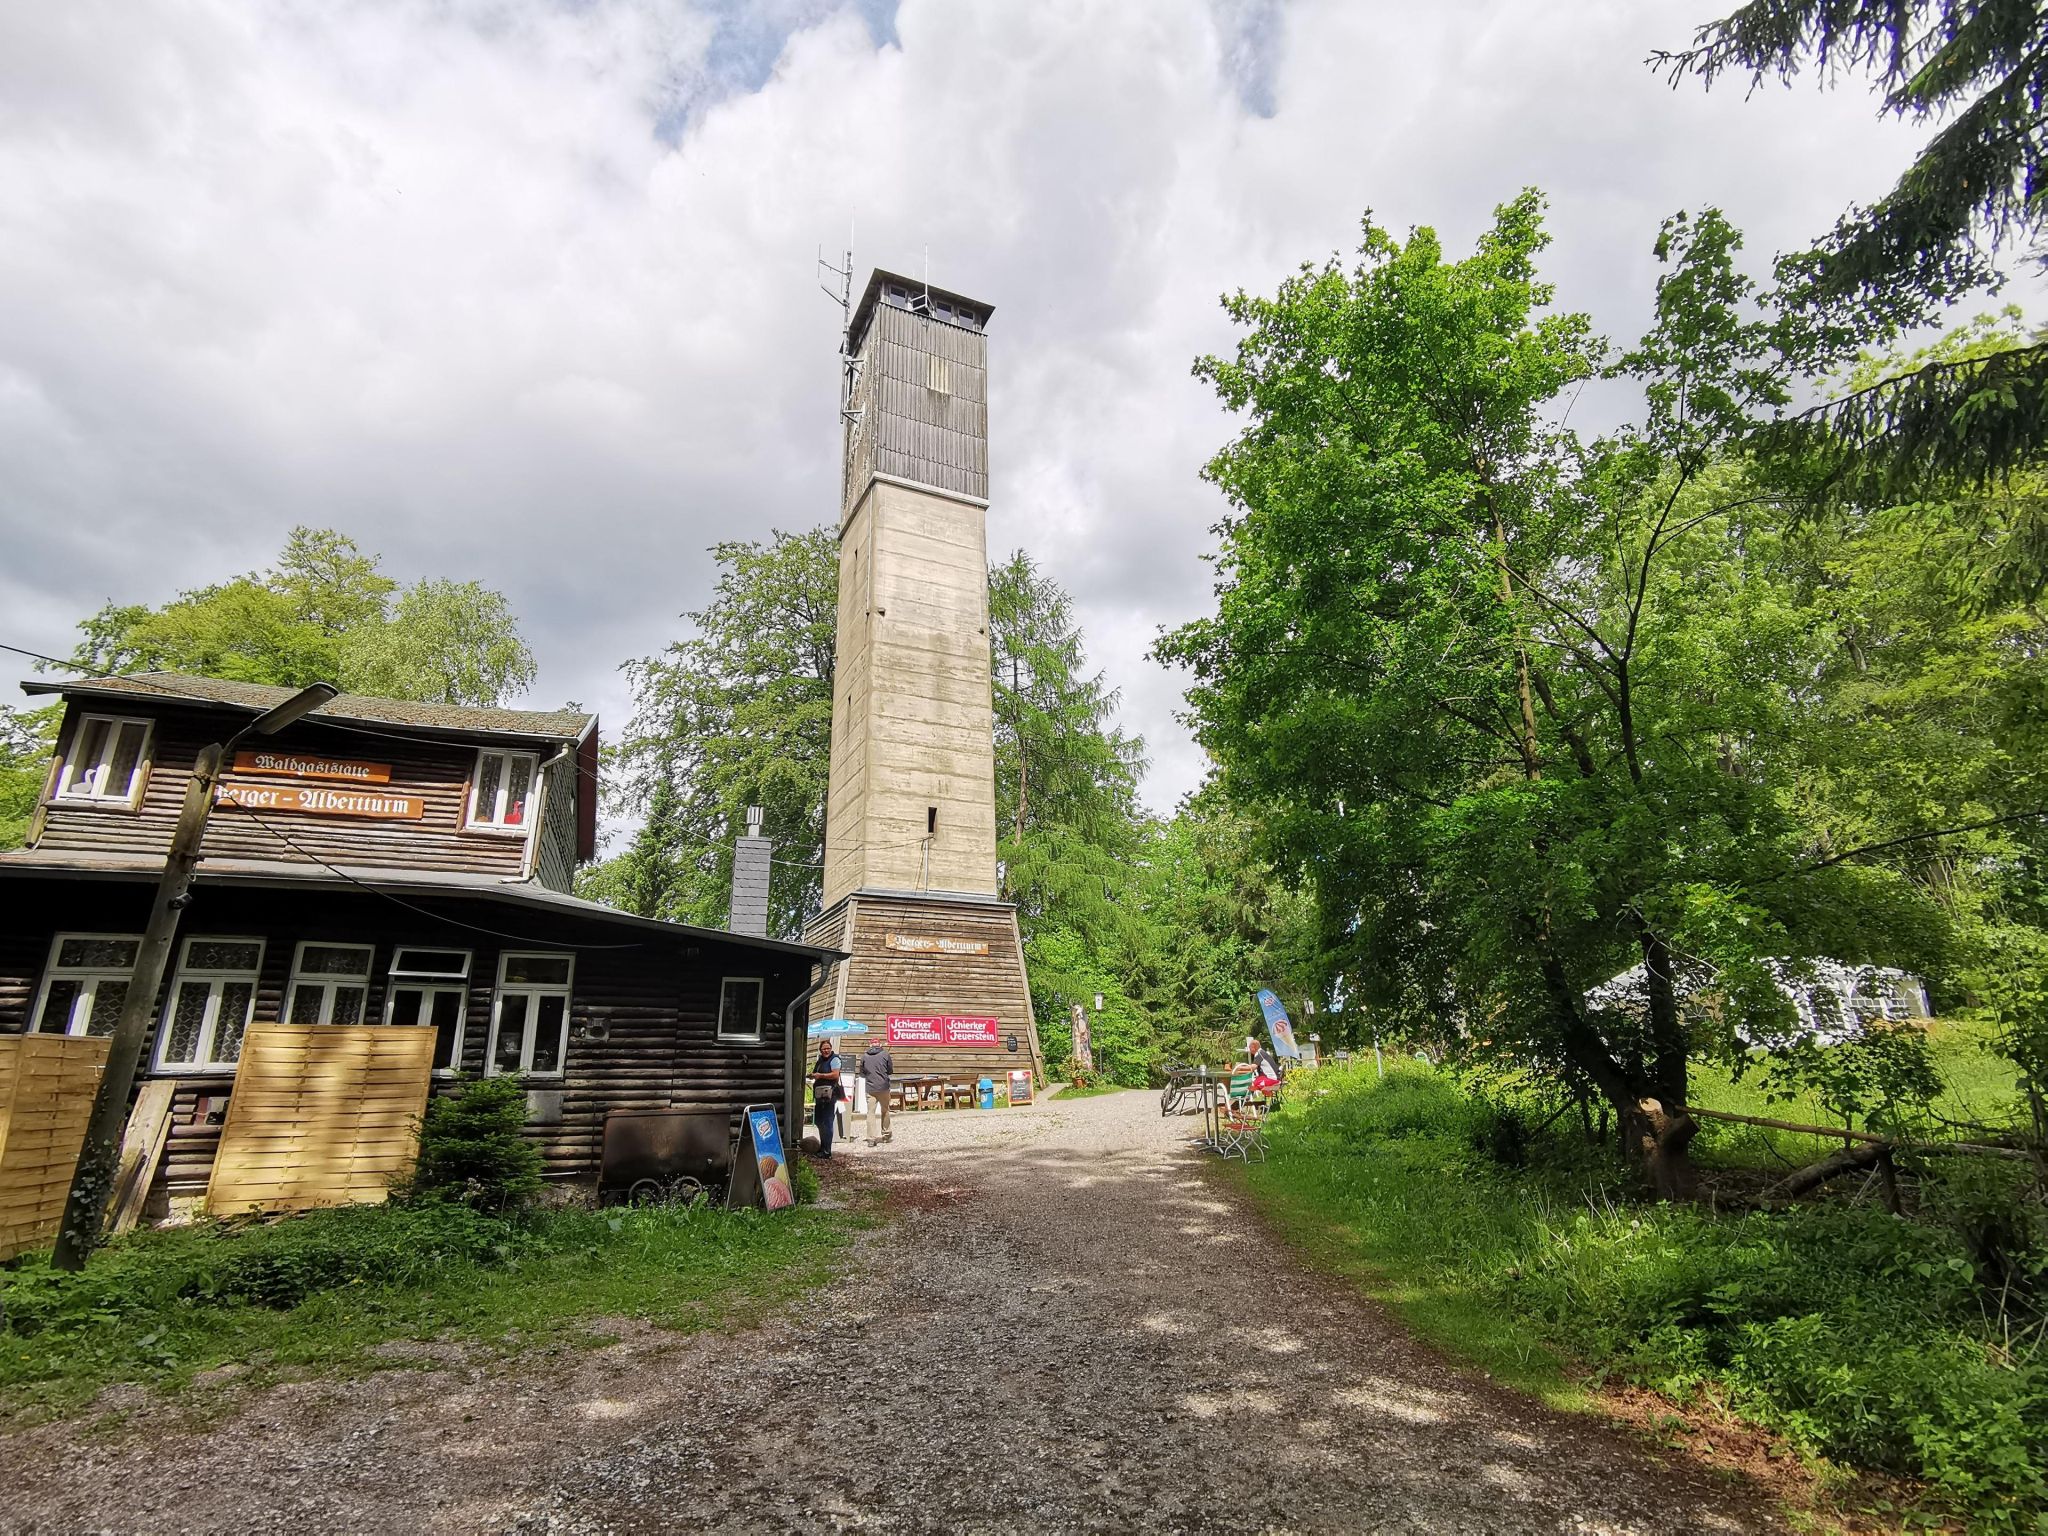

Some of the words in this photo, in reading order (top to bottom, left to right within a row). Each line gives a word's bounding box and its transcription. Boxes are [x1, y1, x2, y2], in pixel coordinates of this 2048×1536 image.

[255, 755, 370, 778] Waldgaststätte
[299, 790, 409, 814] Albertturm
[891, 1018, 932, 1029] Schierker
[947, 1019, 987, 1031] Schierker
[893, 1029, 941, 1041] Feuerstein
[950, 1030, 995, 1042] Feuerstein
